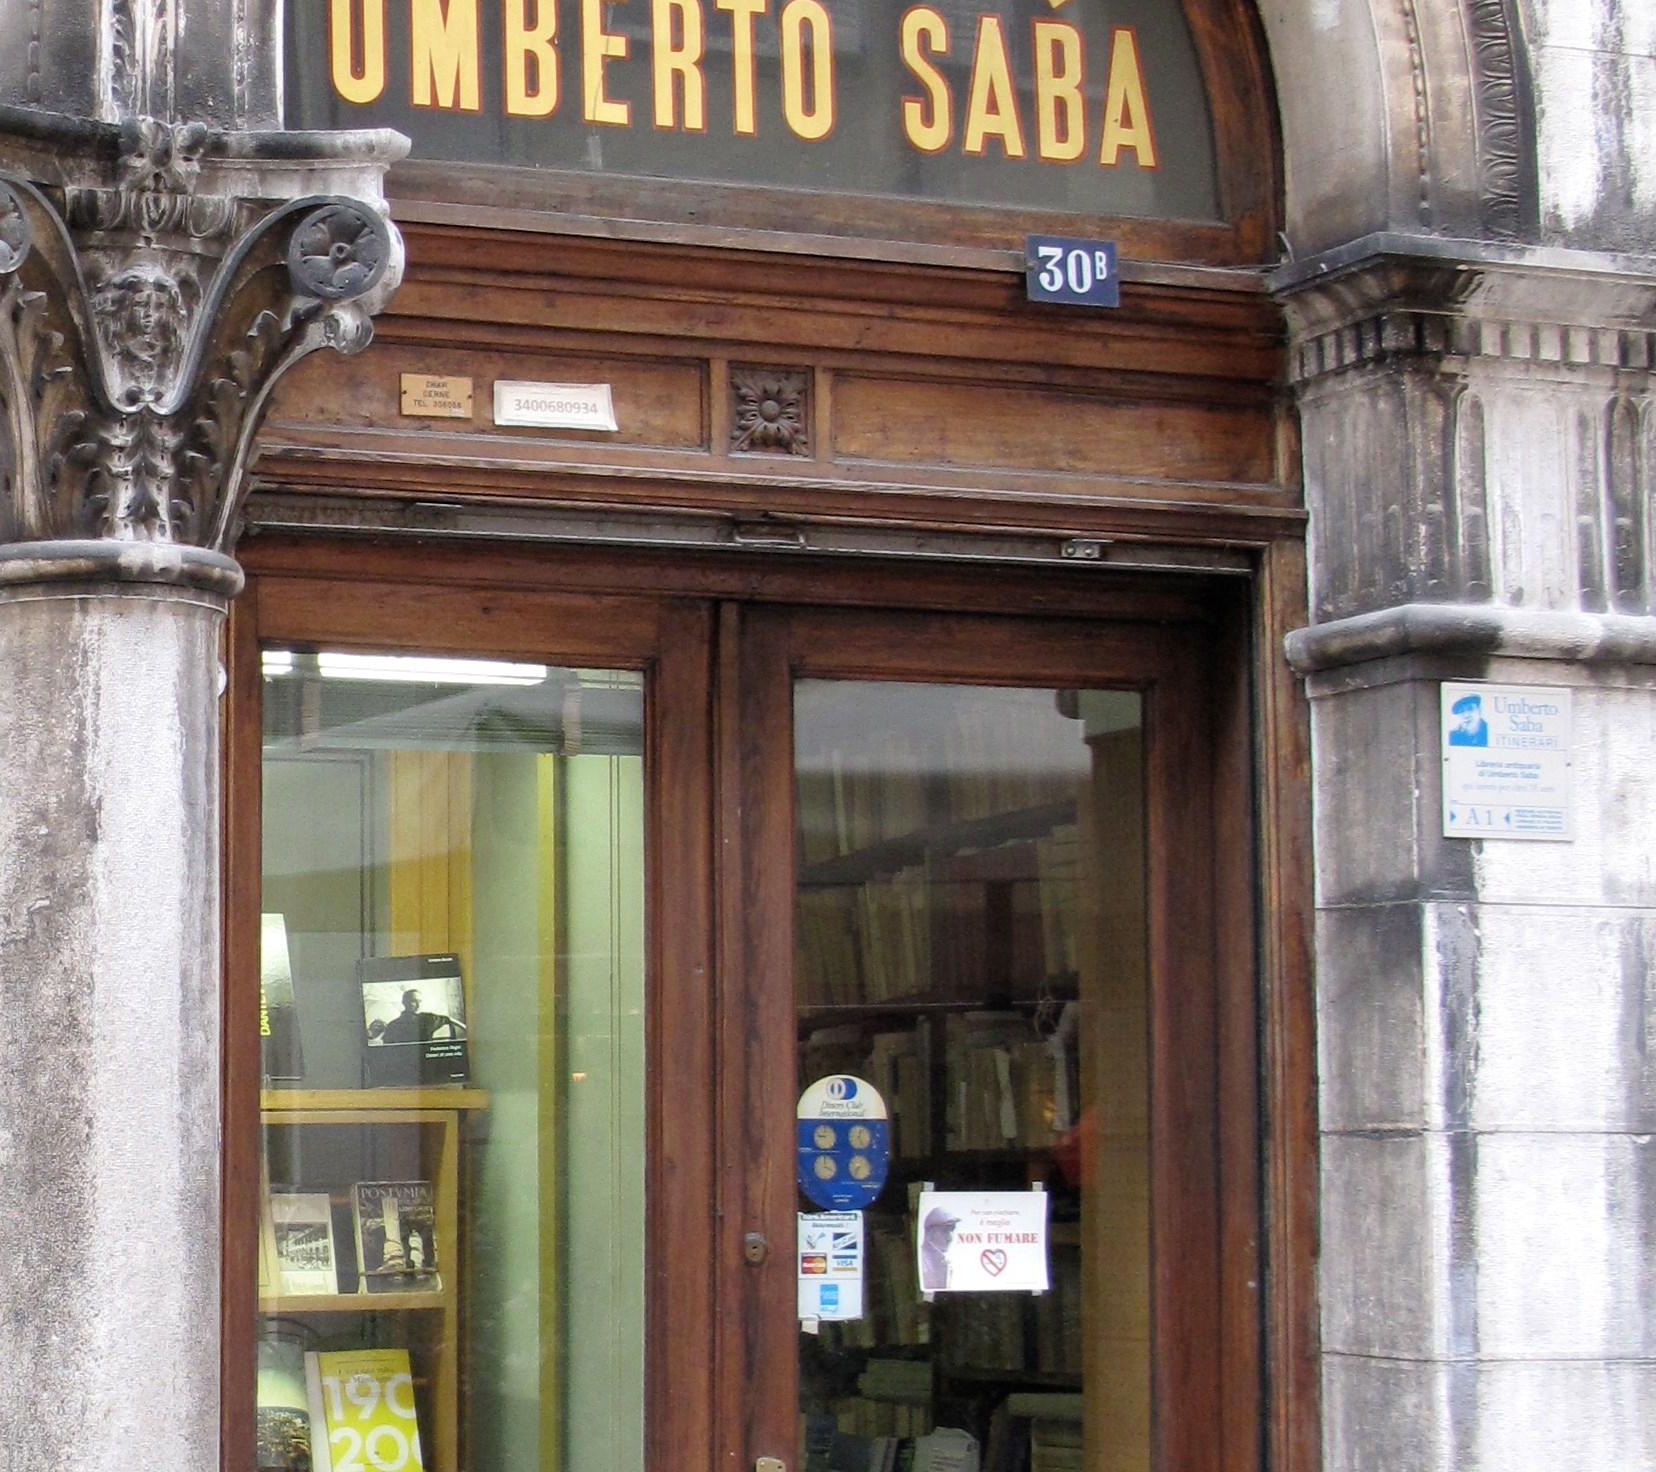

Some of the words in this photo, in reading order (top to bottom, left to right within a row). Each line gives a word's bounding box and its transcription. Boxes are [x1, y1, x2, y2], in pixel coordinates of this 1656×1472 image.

[899, 5, 1158, 170] SABA
[513, 398, 599, 415] 3400680934
[1493, 696, 1559, 716] Umberto
[1509, 716, 1543, 733] Saba
[1496, 736, 1559, 748] ITINERARI
[956, 1233, 983, 1244] NON
[987, 1233, 1039, 1244] FUMARE
